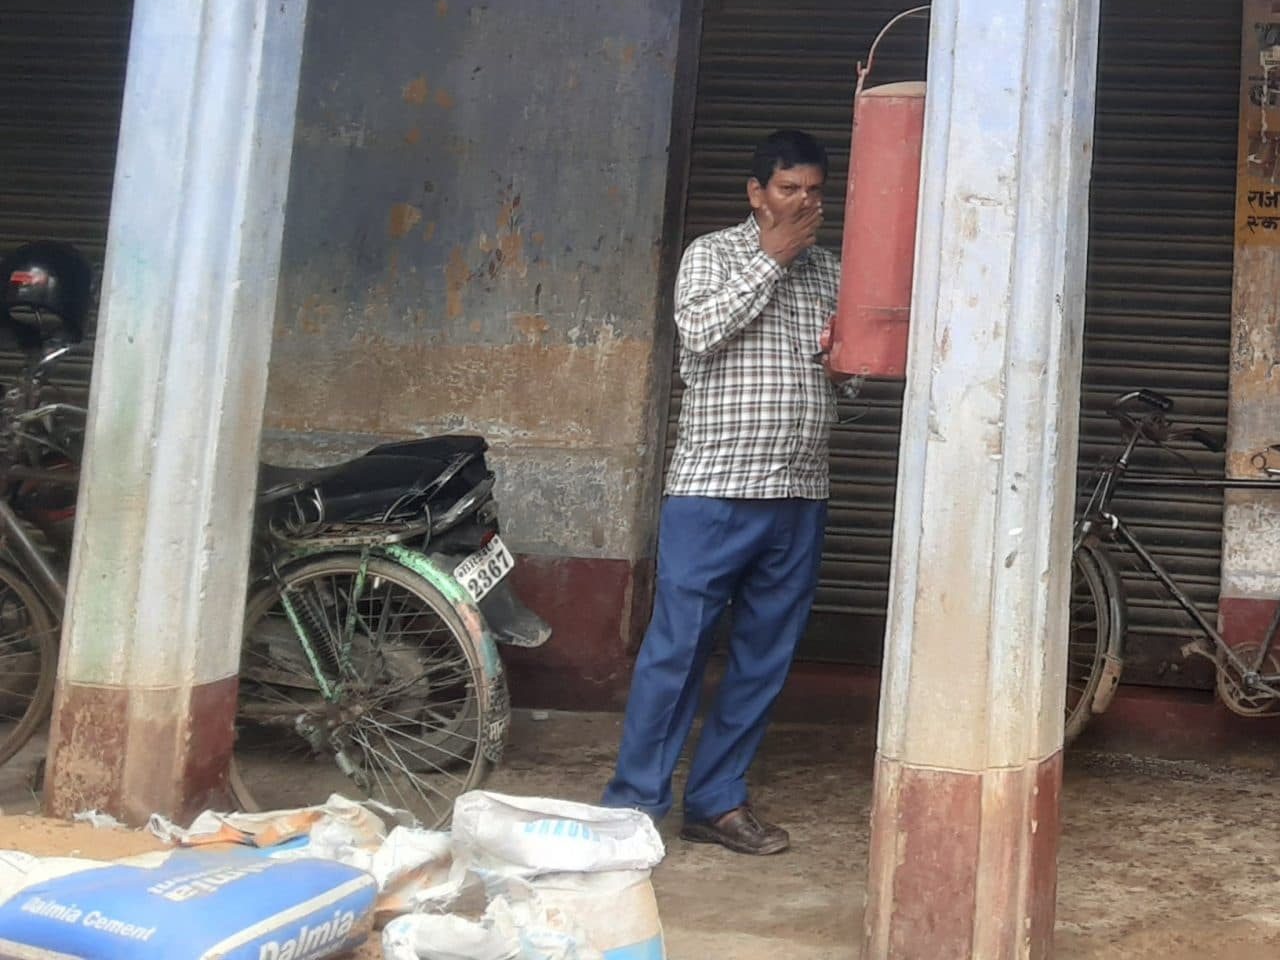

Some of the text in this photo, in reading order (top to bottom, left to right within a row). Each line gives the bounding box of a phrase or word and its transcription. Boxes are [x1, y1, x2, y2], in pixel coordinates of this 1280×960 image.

[467, 548, 510, 599] 2367
[21, 896, 157, 942] Dalmia Cement
[259, 909, 355, 960] Dalmia
